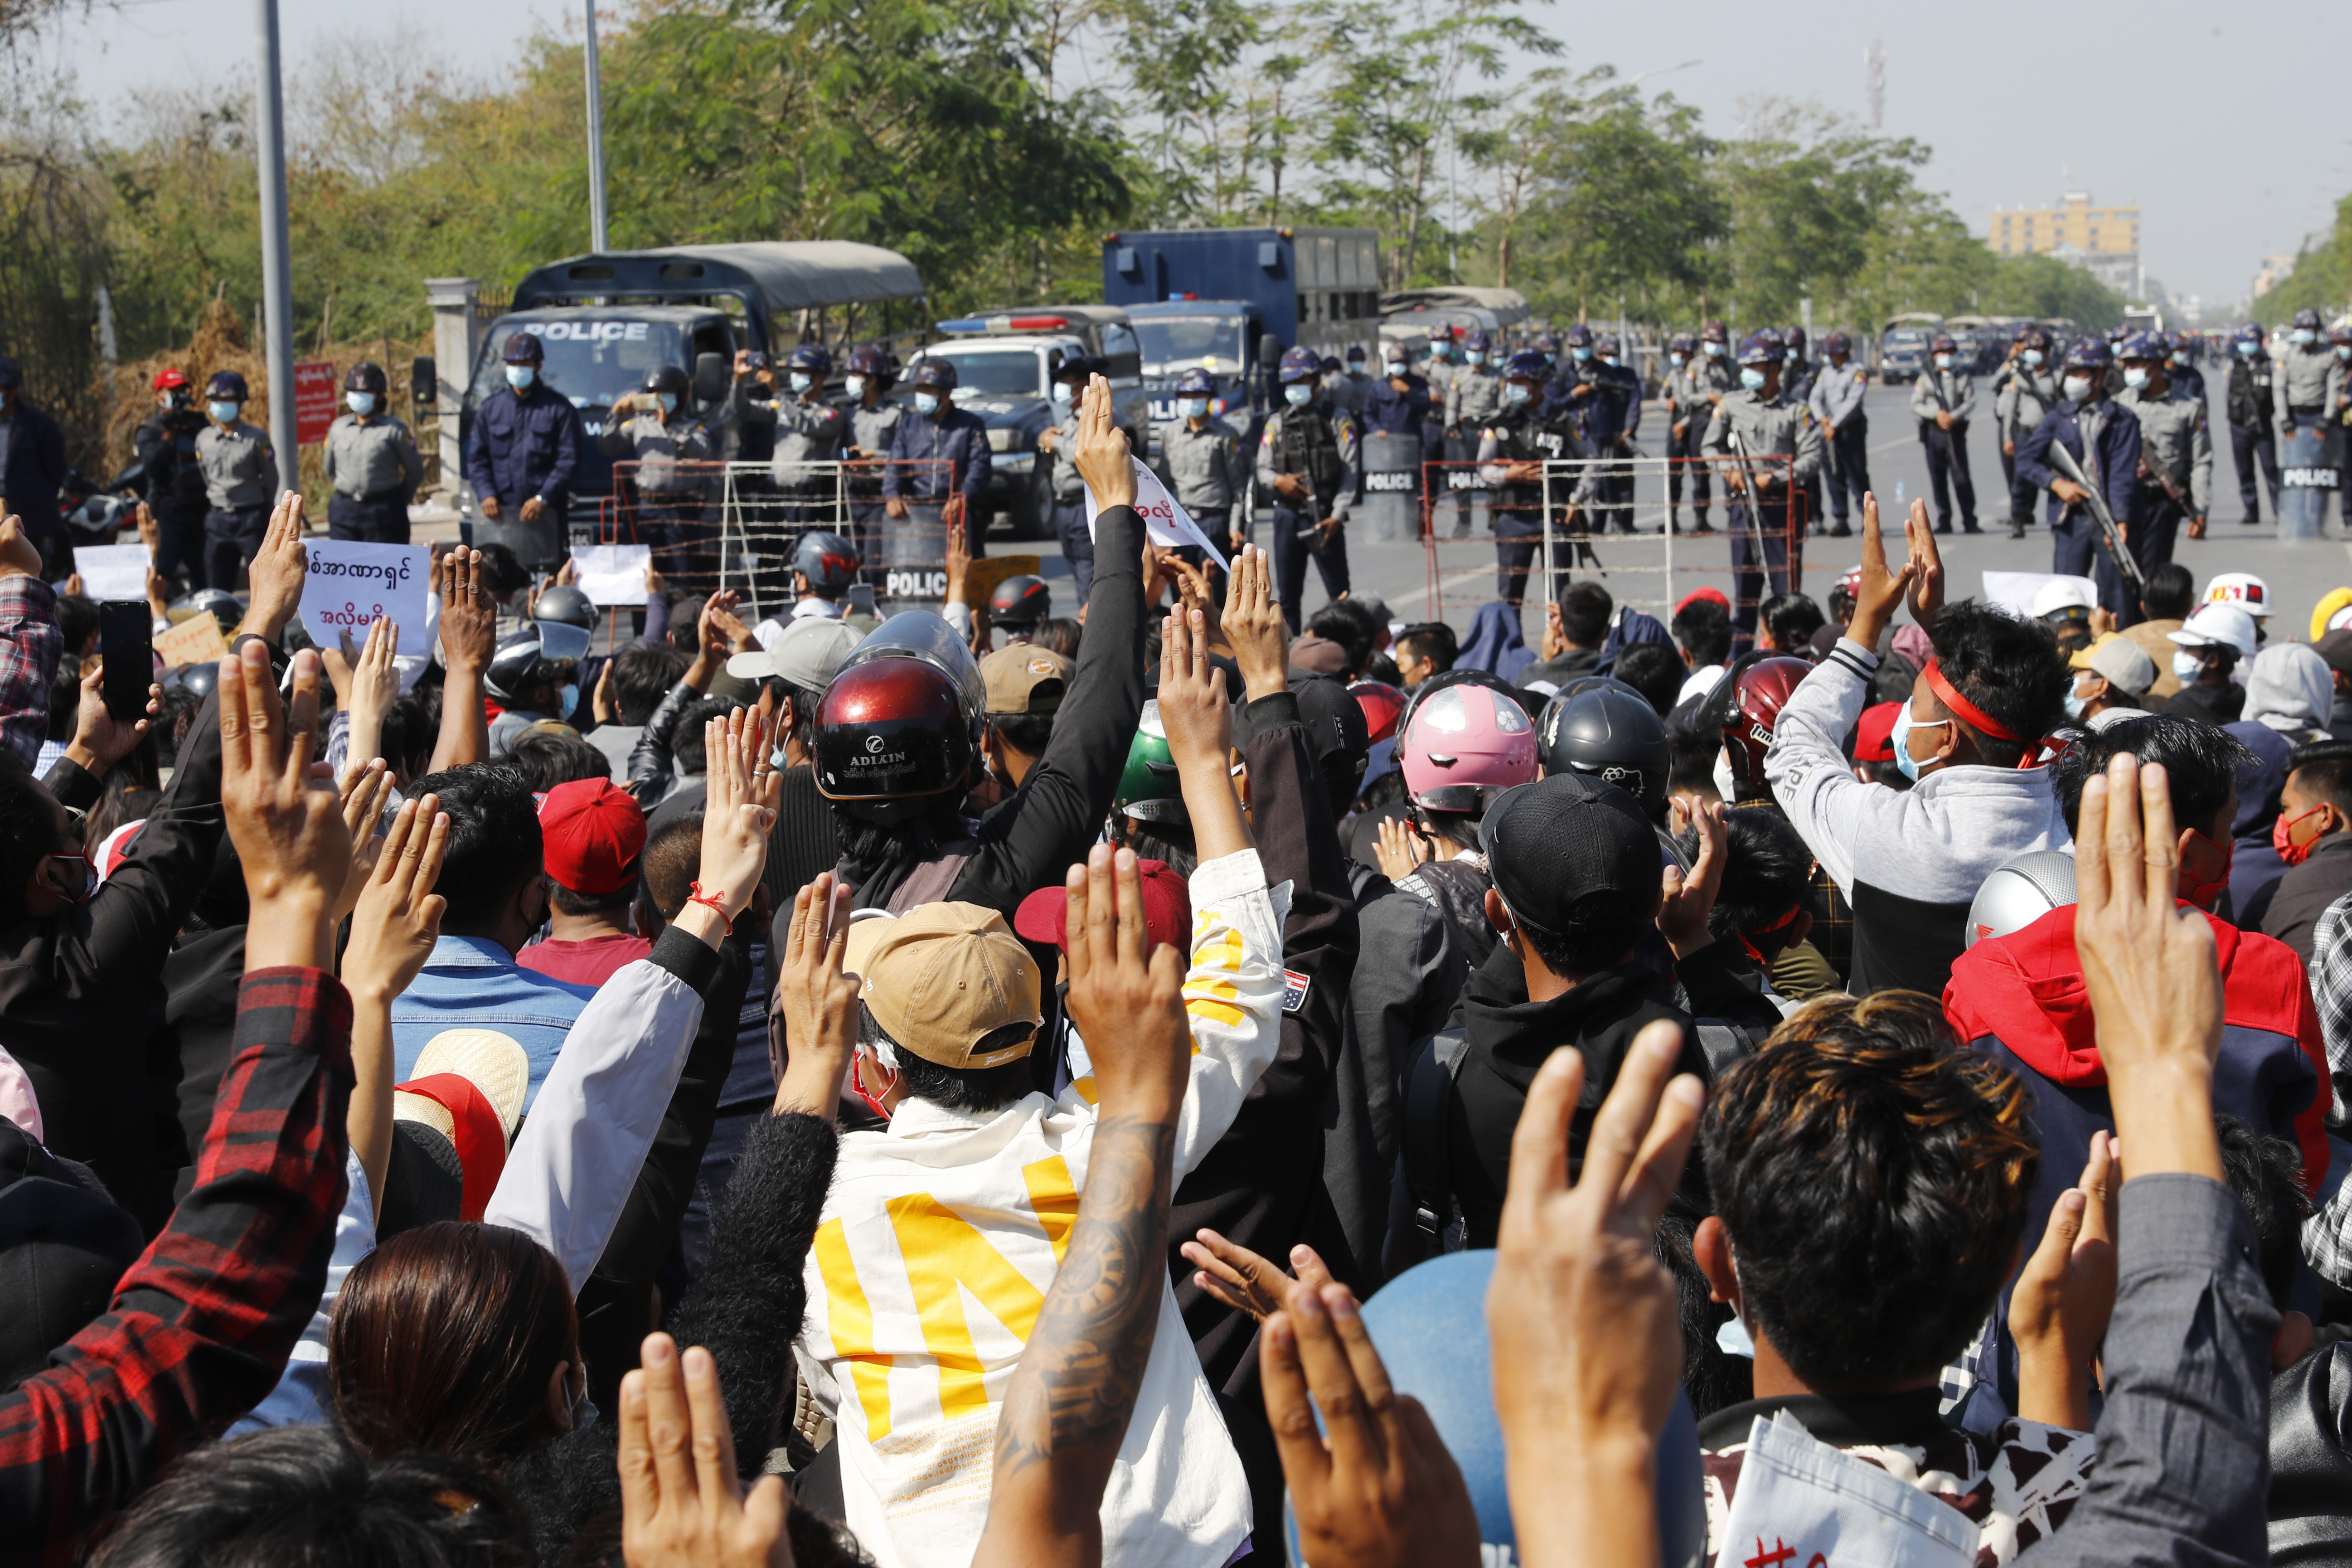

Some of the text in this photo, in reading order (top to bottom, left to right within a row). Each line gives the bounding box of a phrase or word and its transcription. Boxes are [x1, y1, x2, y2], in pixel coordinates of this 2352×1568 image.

[524, 322, 649, 340] POLICE
[1366, 473, 1413, 490] POLICE
[2284, 468, 2338, 486] POLICE
[305, 551, 411, 589] စ်အာဏာရှင်
[887, 572, 948, 597] POLIC
[850, 752, 905, 766] ADIXIN
